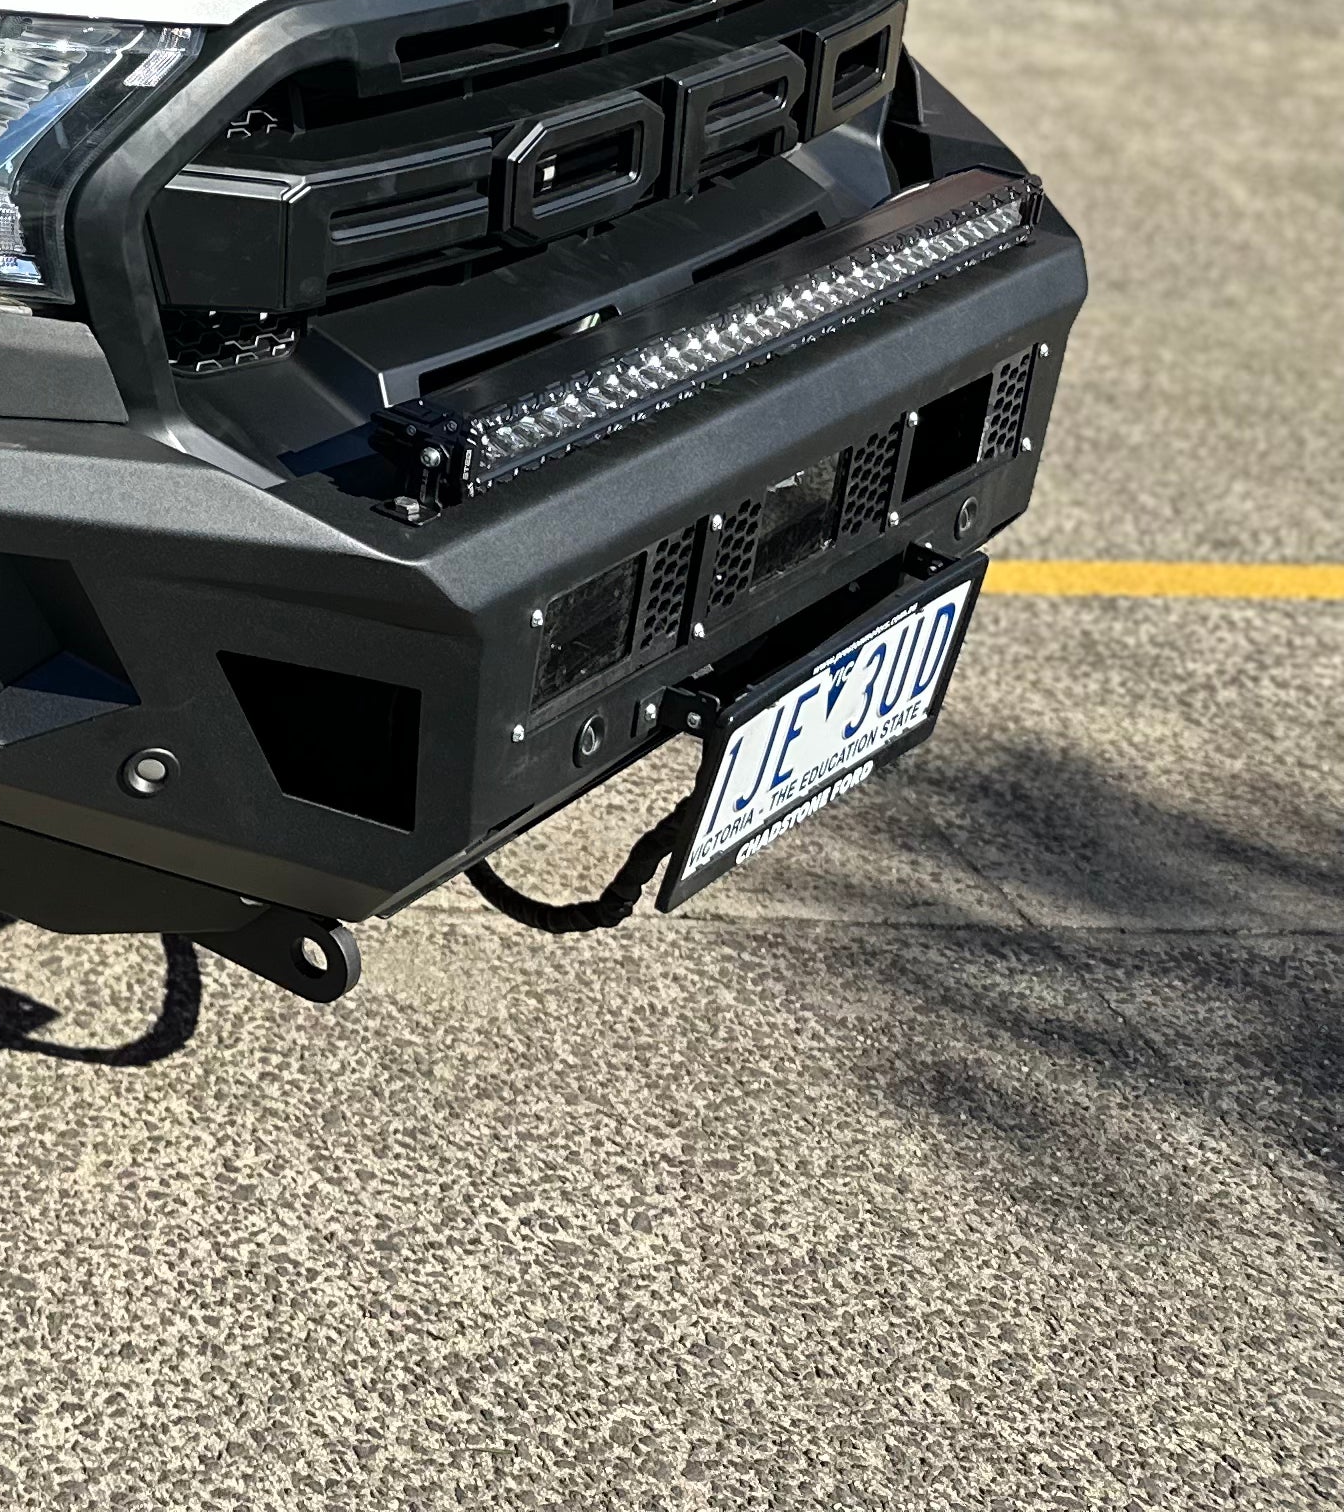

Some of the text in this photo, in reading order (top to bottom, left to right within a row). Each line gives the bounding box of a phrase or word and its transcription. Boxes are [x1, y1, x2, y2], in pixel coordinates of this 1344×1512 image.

[688, 807, 754, 867] VICTORIA
[768, 779, 798, 812] THE
[798, 725, 878, 793] EDUCATION
[879, 700, 922, 740] STATE
[735, 759, 874, 865] CHADSTONE FORD
